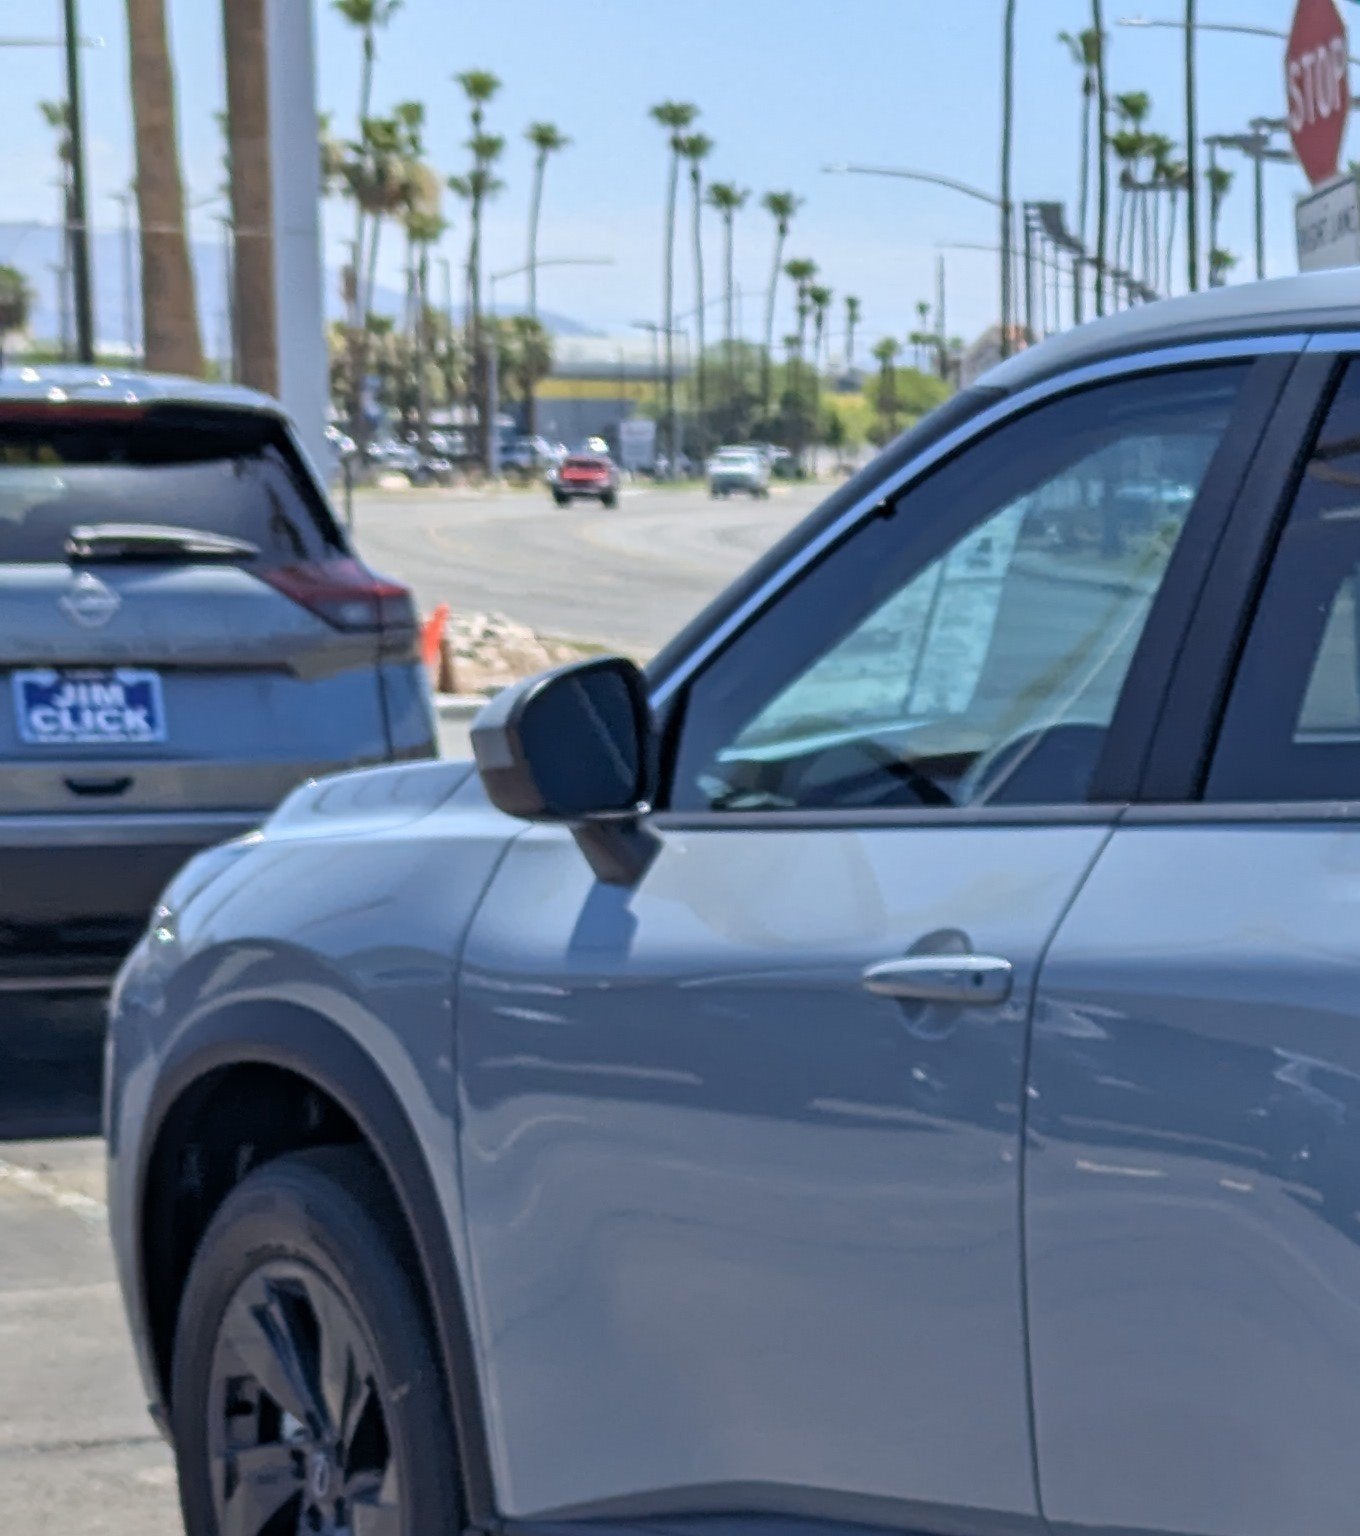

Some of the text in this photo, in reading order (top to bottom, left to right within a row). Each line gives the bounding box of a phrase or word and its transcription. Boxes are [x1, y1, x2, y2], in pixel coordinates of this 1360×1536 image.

[1288, 37, 1347, 132] STOP
[53, 682, 125, 708] JIM
[31, 705, 152, 733] CLICK
